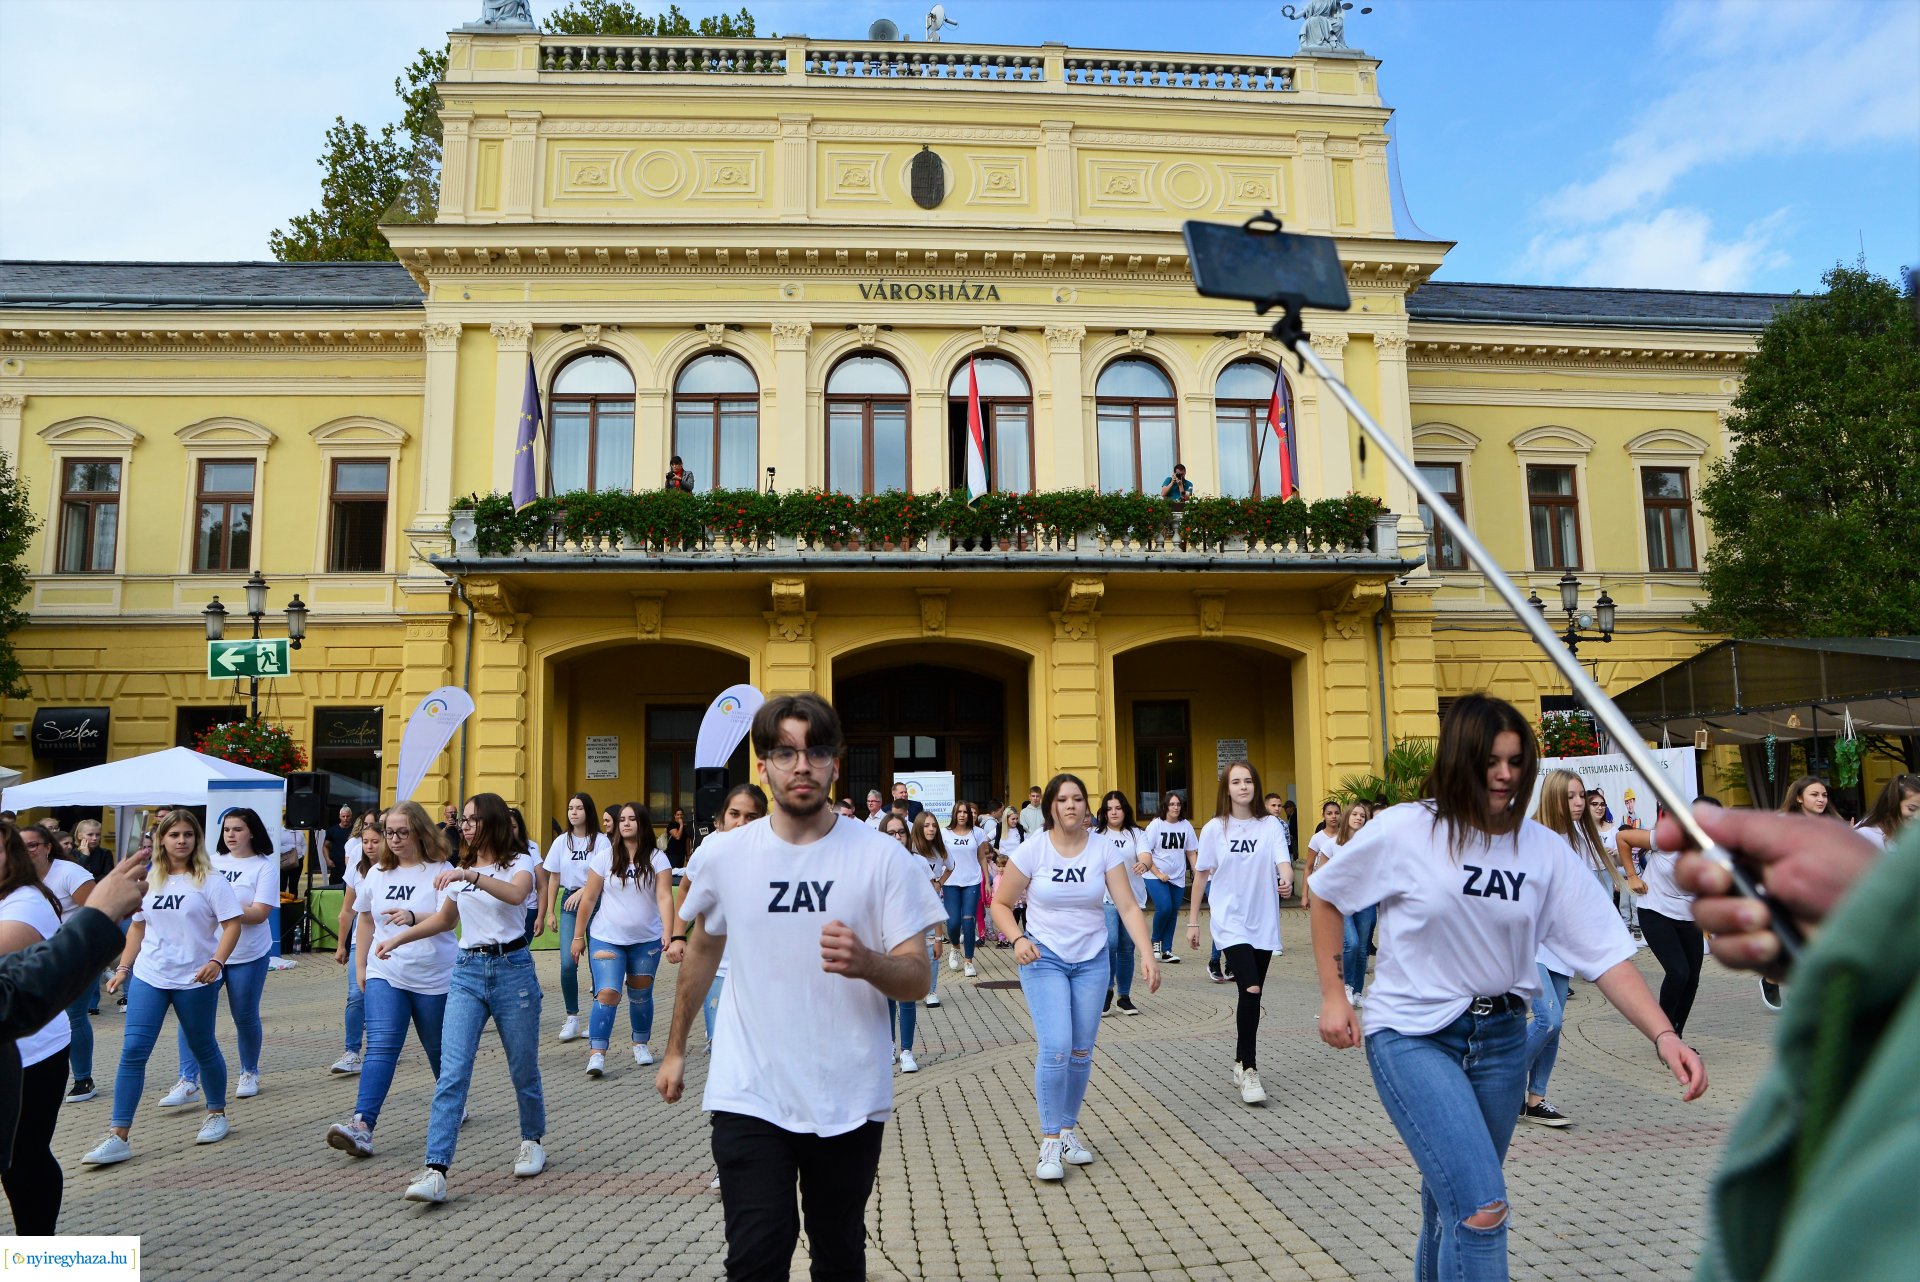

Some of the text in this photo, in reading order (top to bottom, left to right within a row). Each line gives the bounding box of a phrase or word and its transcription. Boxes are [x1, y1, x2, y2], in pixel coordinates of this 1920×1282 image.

[858, 279, 1000, 301] VÁROSHÁZA
[1111, 839, 1126, 848] AY
[1160, 832, 1186, 850] ZAY
[1230, 839, 1258, 853] ZAY
[571, 851, 589, 861] ZAY
[1051, 866, 1087, 883] ZAY
[1462, 864, 1526, 902] ZAY
[385, 886, 416, 901] ZAY
[767, 880, 834, 913] ZAY
[152, 895, 185, 910] ZAY
